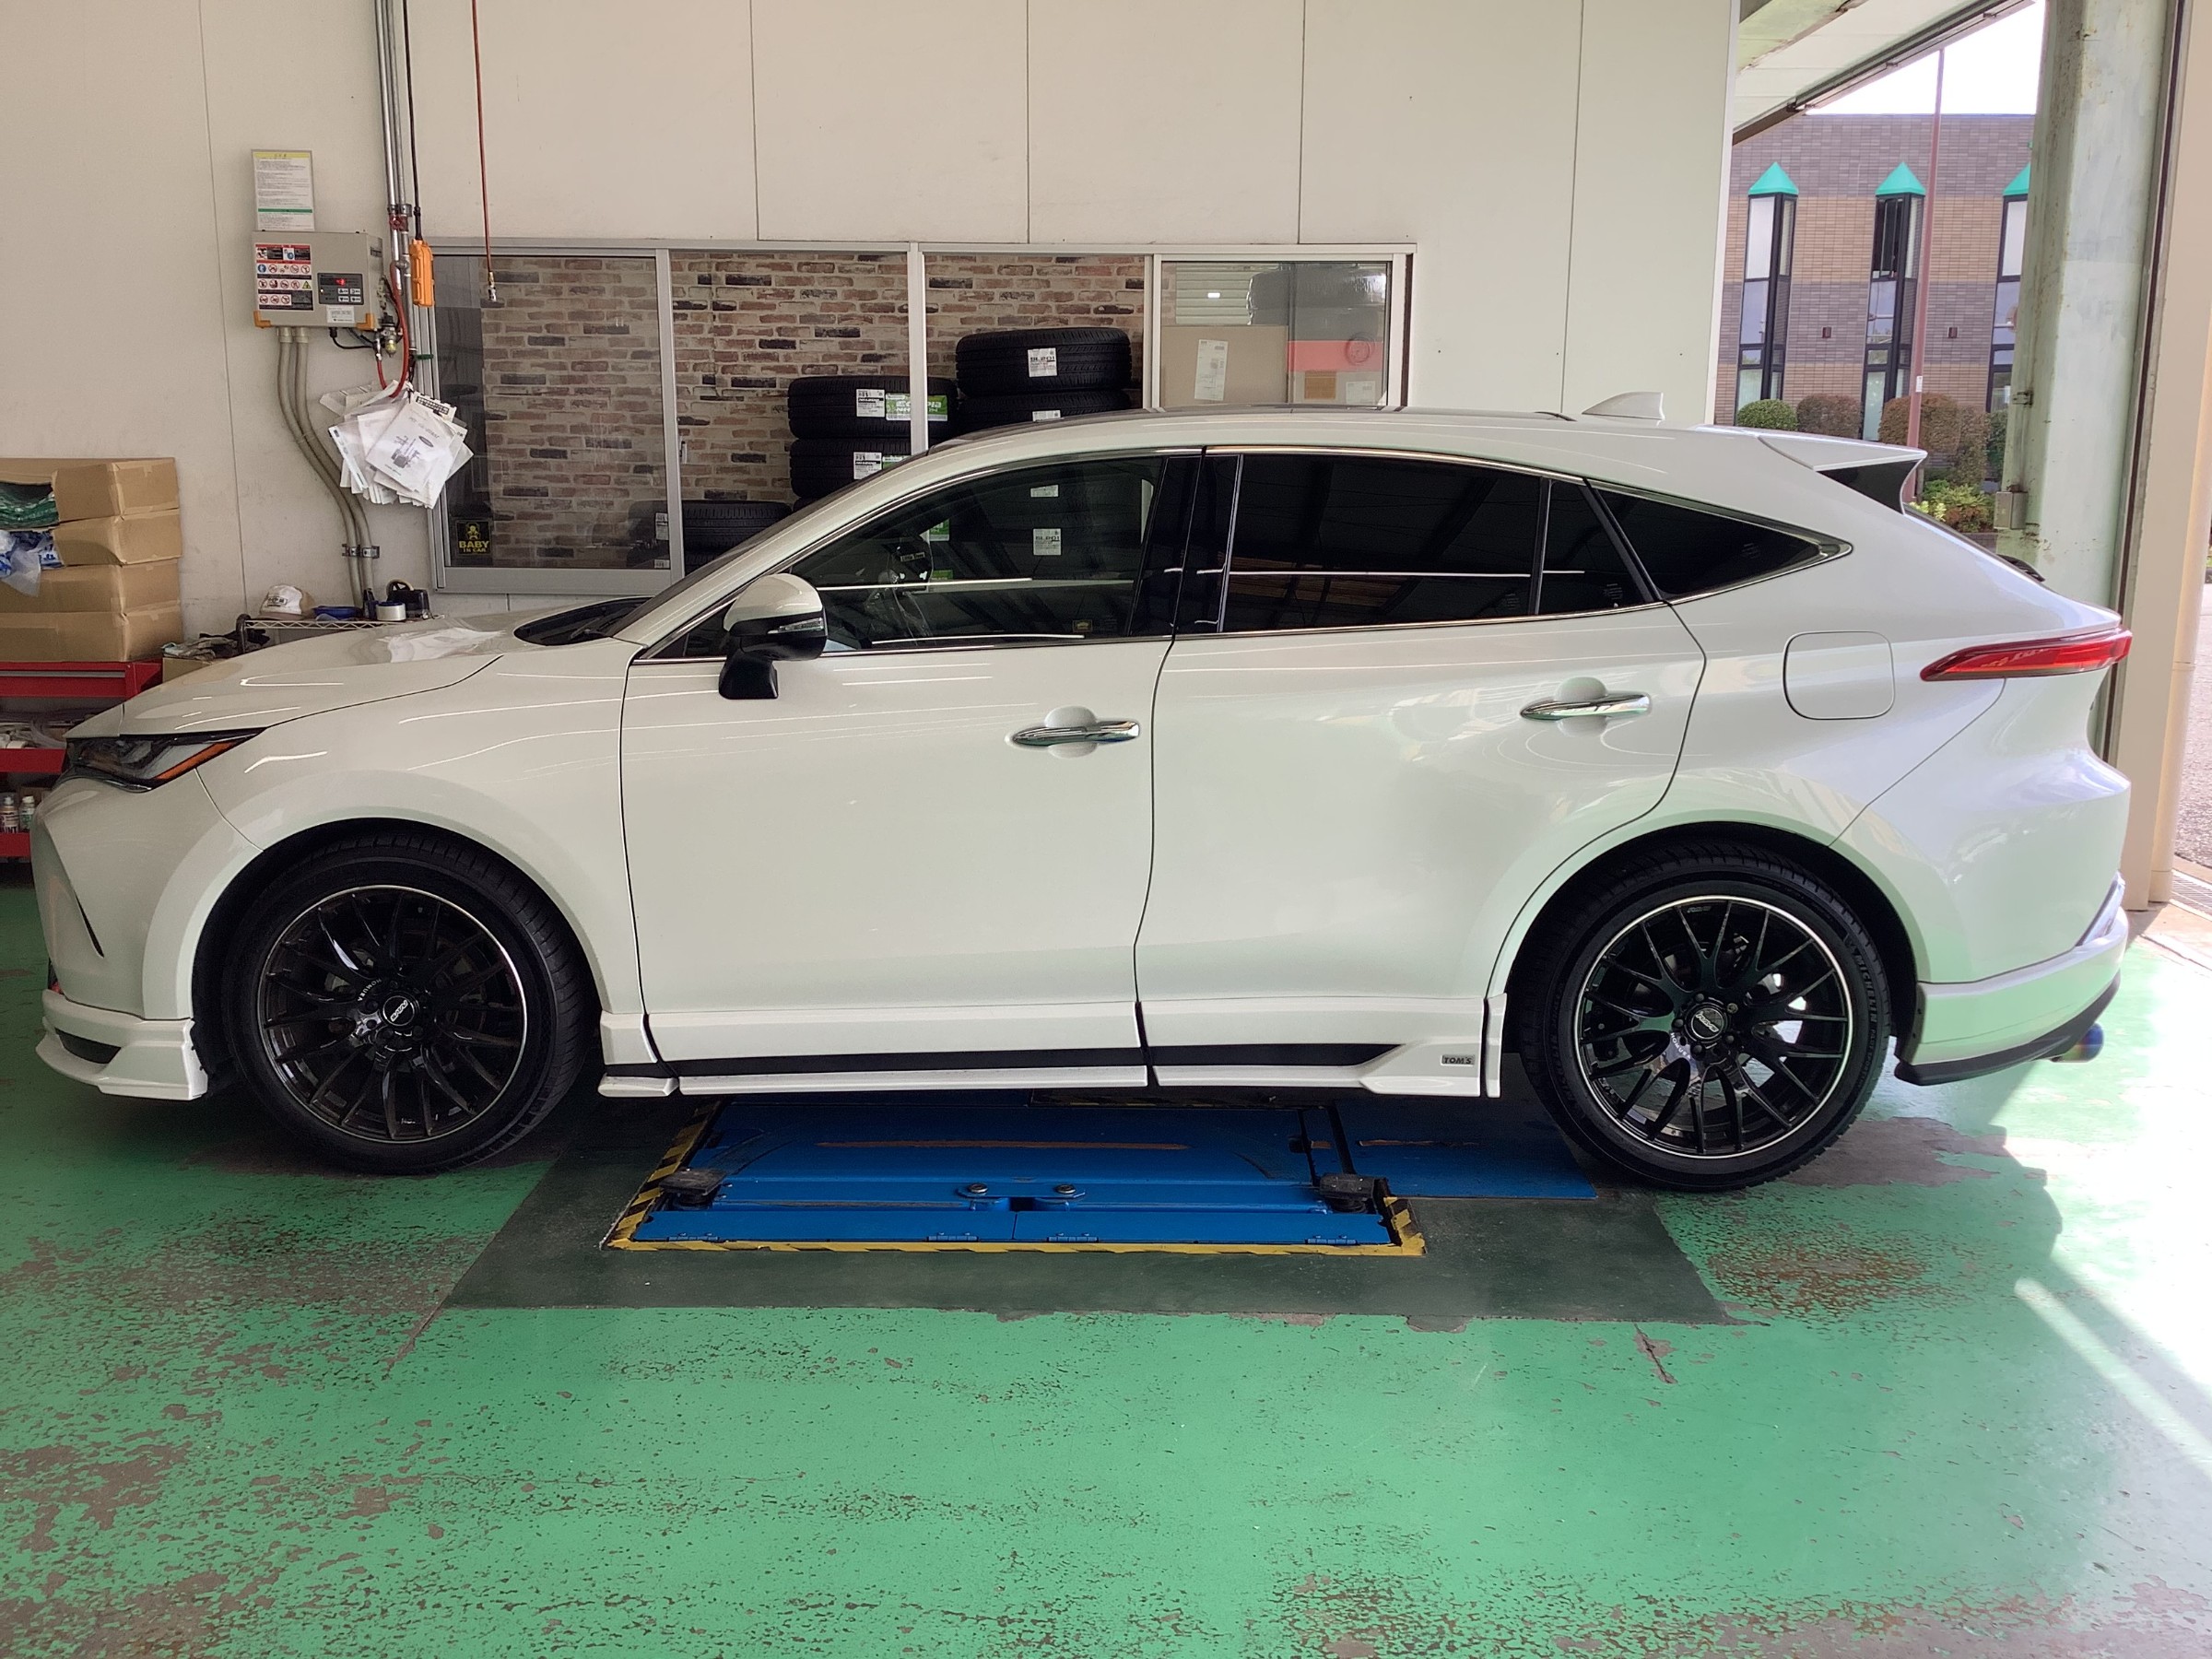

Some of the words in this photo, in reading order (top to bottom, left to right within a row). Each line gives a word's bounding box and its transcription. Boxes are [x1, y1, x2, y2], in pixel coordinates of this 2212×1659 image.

[459, 540, 489, 548] BABY
[357, 978, 382, 1002] HOMURA
[1853, 953, 1878, 1023] MICHELIN
[1695, 1011, 1720, 1033] RAYS
[1670, 1032, 1691, 1059] HOMURA
